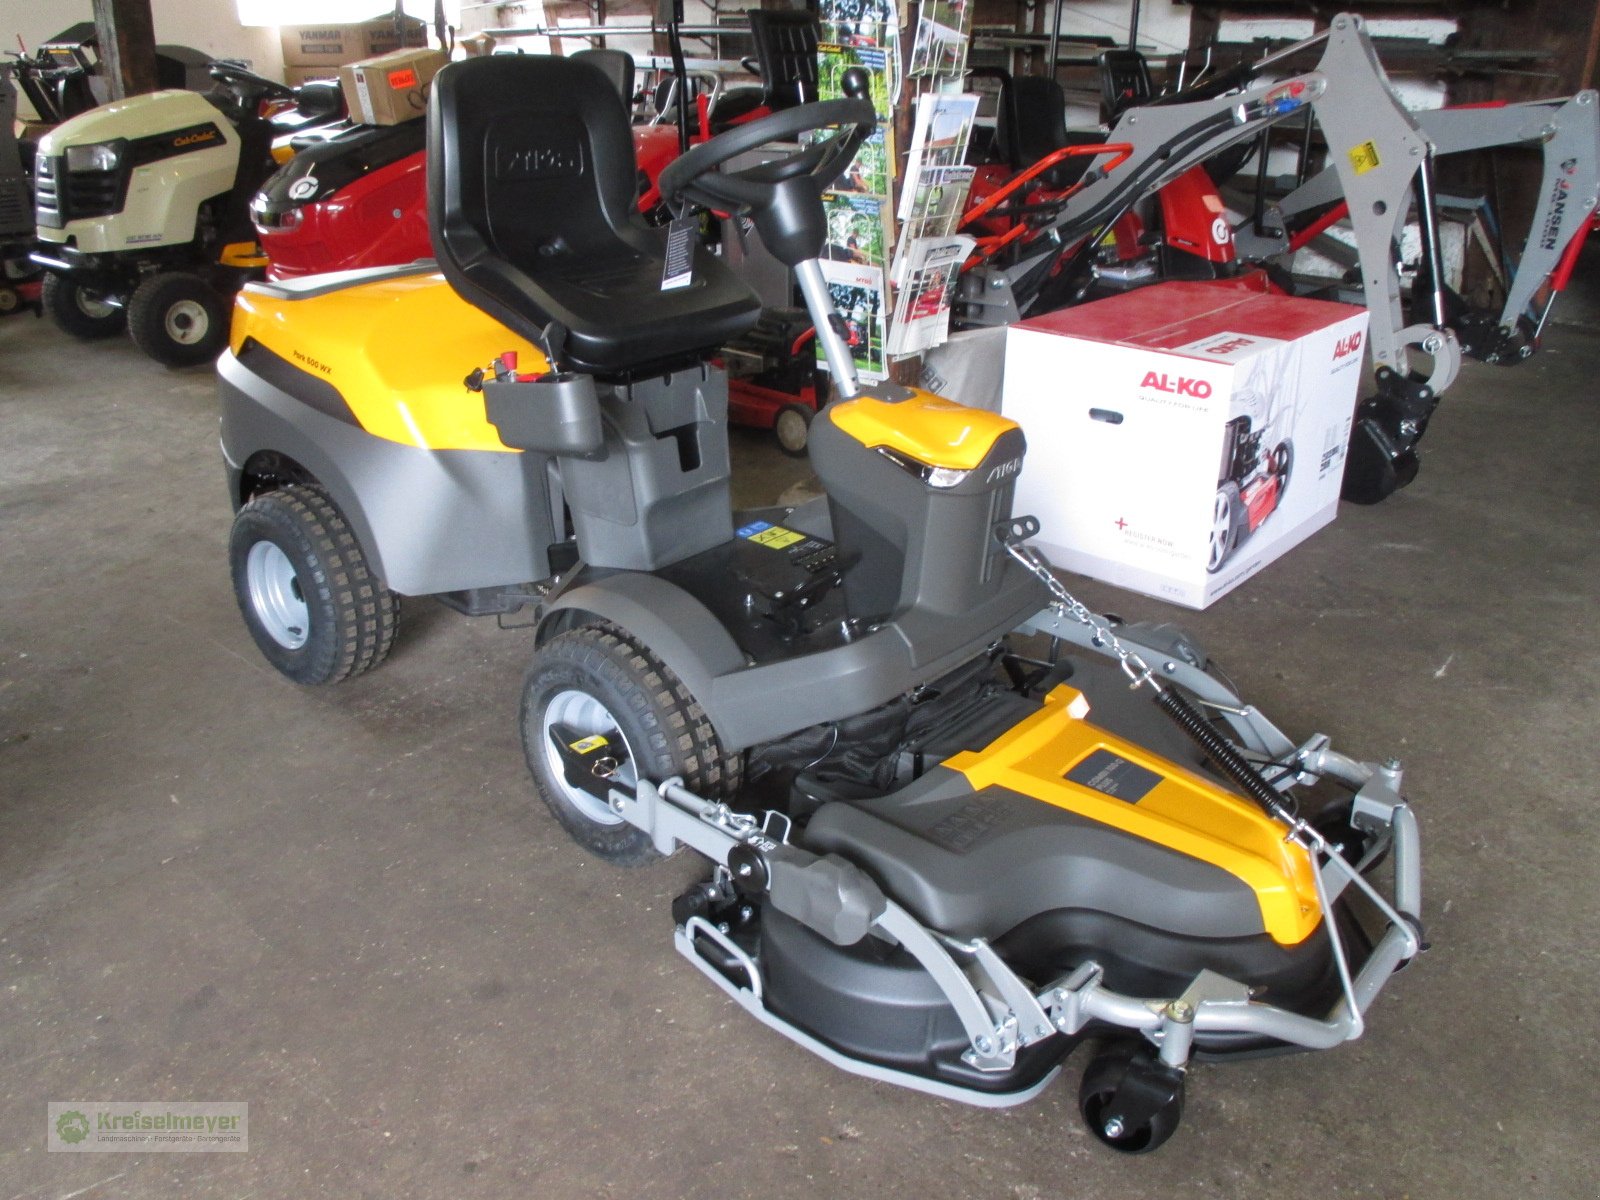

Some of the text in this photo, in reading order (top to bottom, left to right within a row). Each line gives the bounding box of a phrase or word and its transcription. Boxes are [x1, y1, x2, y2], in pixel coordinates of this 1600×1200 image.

[299, 30, 341, 40] YANMAR
[174, 136, 191, 146] Cub
[1545, 180, 1570, 250] JANSEN
[1332, 330, 1362, 361] AL-KO
[293, 349, 305, 361] Park
[320, 363, 333, 375] WX
[1140, 371, 1212, 399] AL-KO
[1124, 529, 1174, 547] REGISTER NOW
